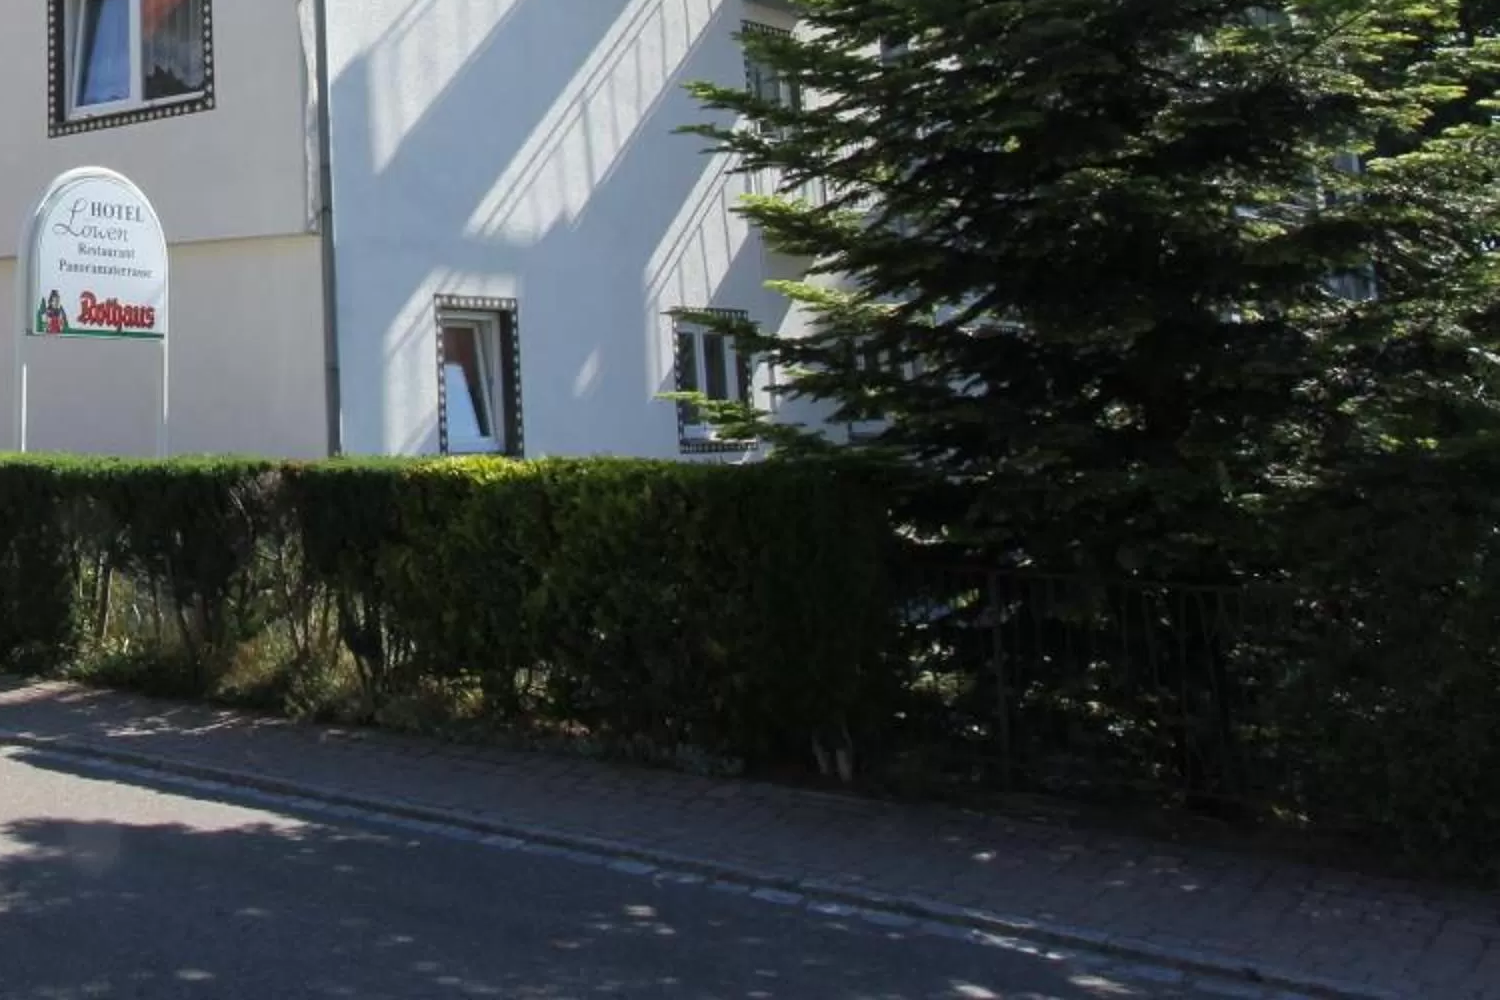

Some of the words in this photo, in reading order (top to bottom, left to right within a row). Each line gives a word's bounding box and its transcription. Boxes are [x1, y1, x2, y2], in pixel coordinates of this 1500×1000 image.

[90, 201, 144, 222] HOTEL
[78, 242, 135, 260] Restaurant
[77, 291, 155, 332] Rothaus
